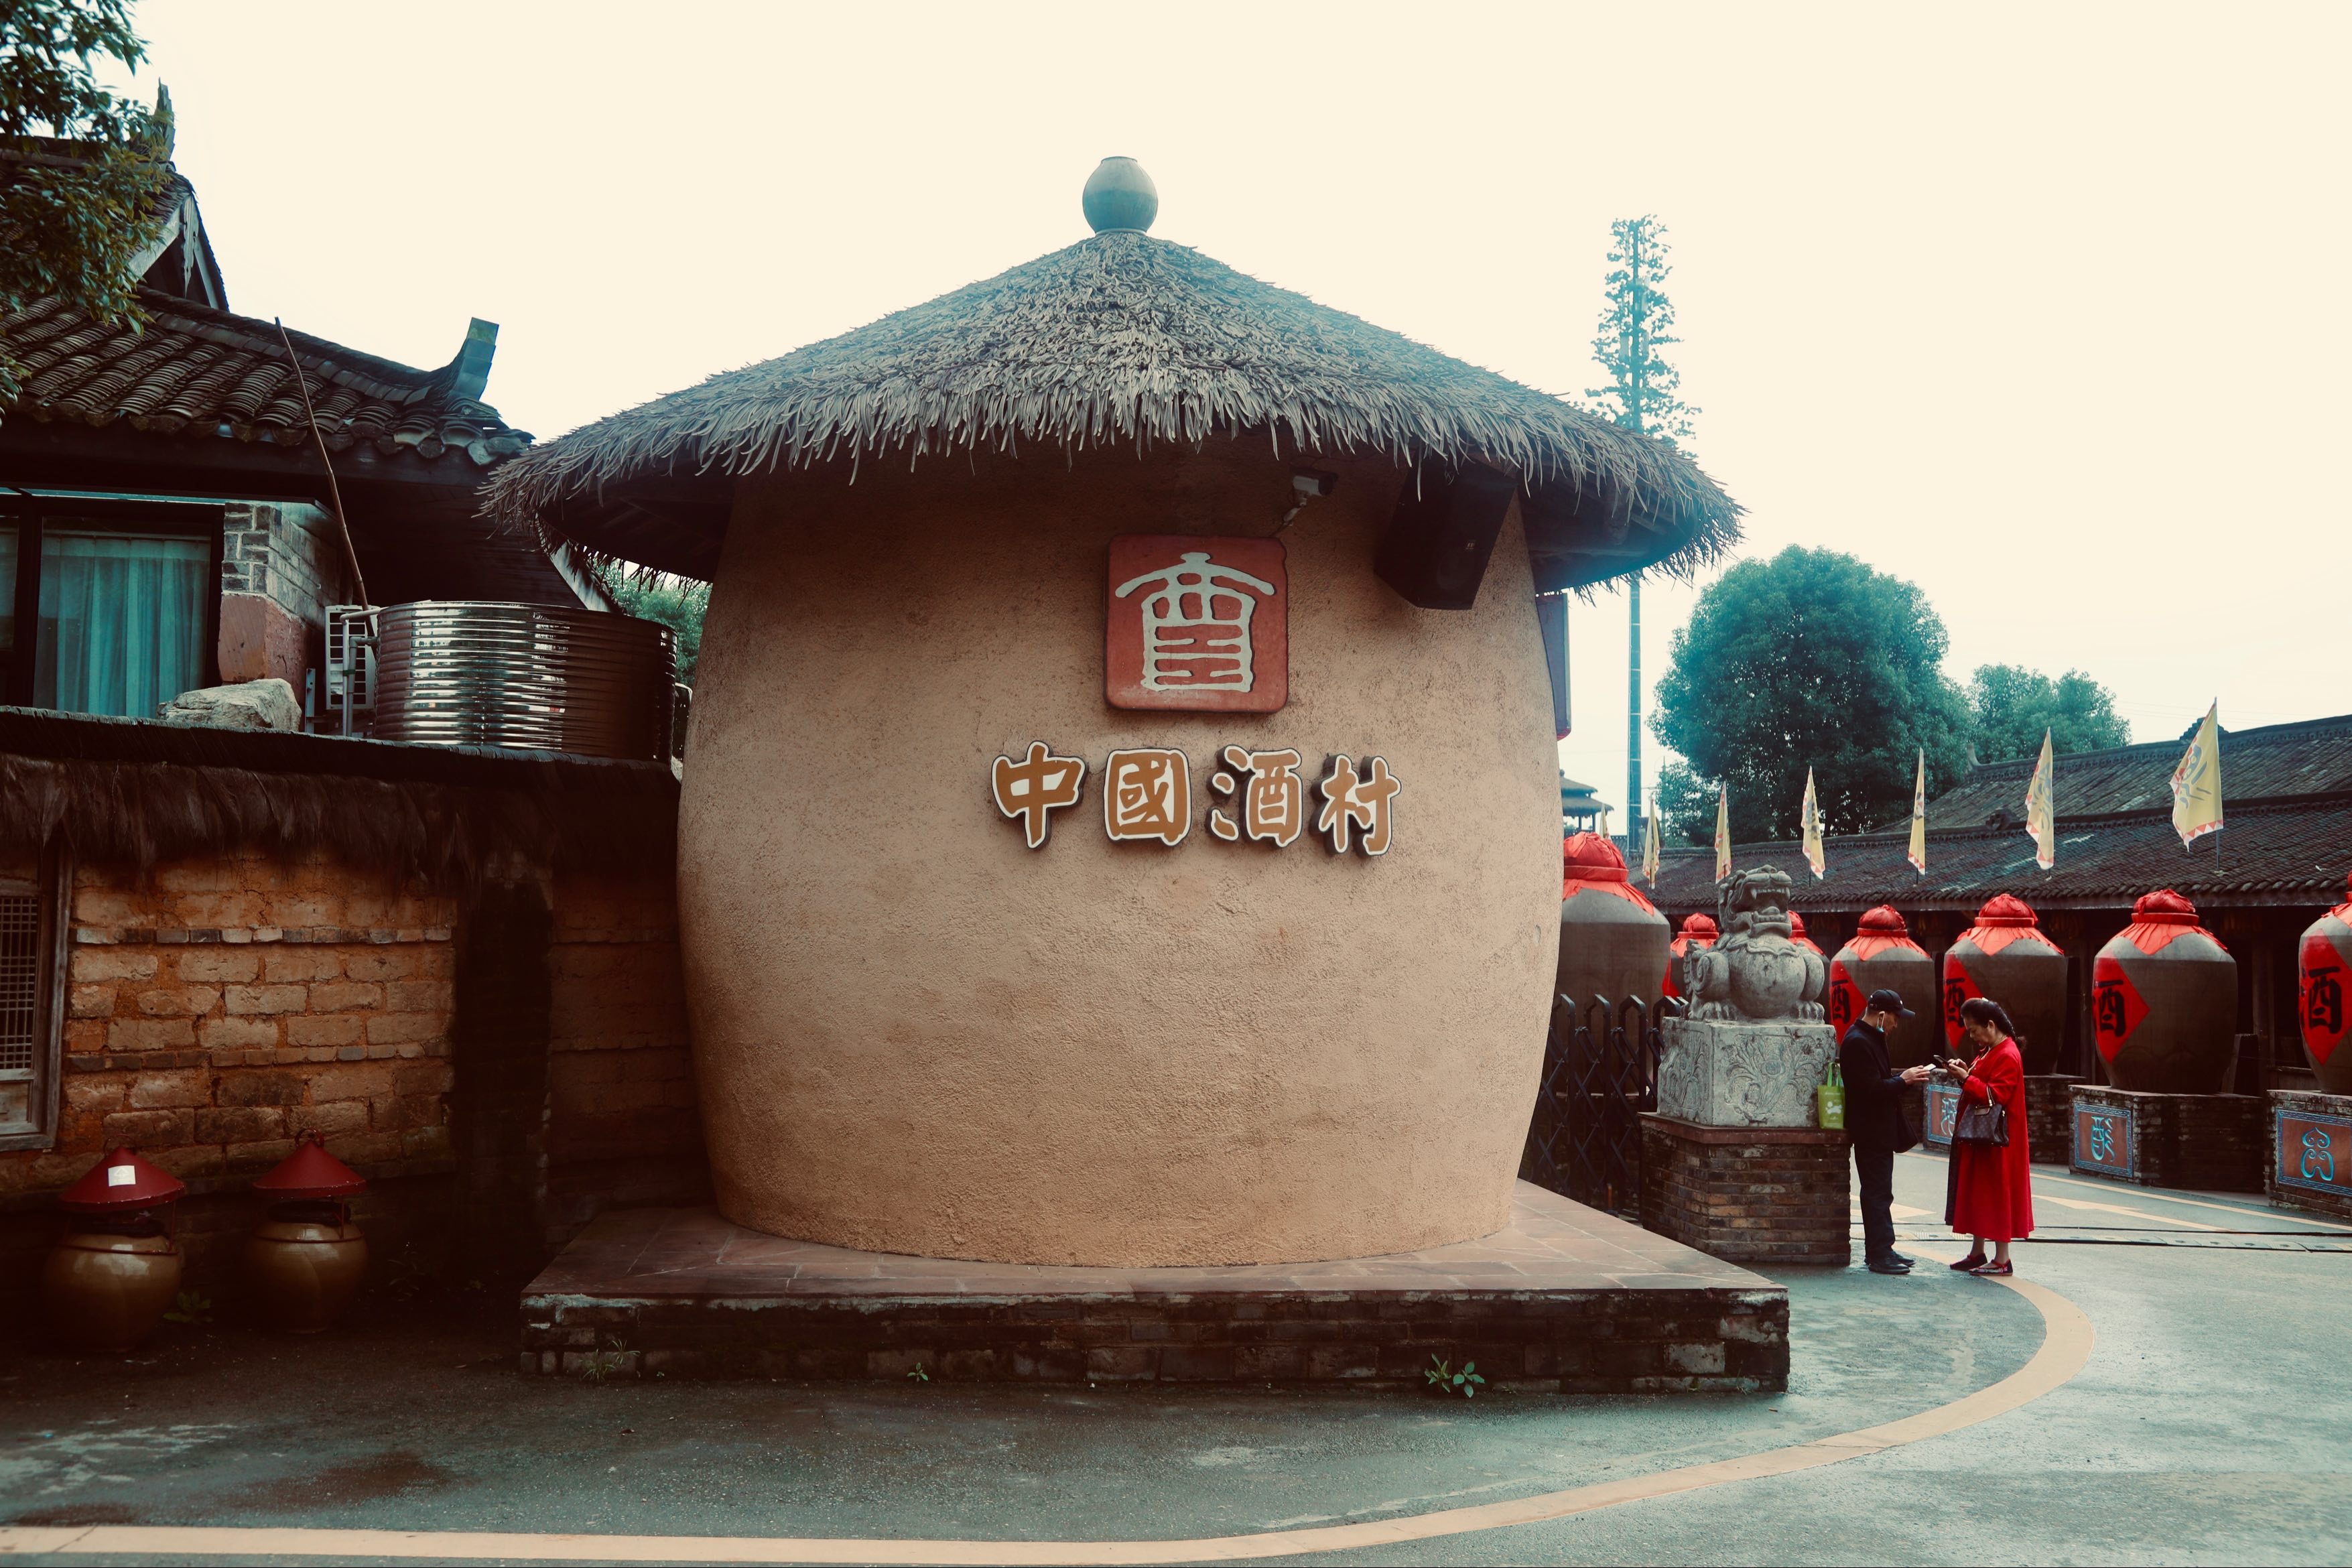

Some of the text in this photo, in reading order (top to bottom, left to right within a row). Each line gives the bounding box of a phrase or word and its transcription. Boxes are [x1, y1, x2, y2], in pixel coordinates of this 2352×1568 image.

[992, 740, 1401, 856] 中國酒村
[2300, 966, 2342, 1034] 酒
